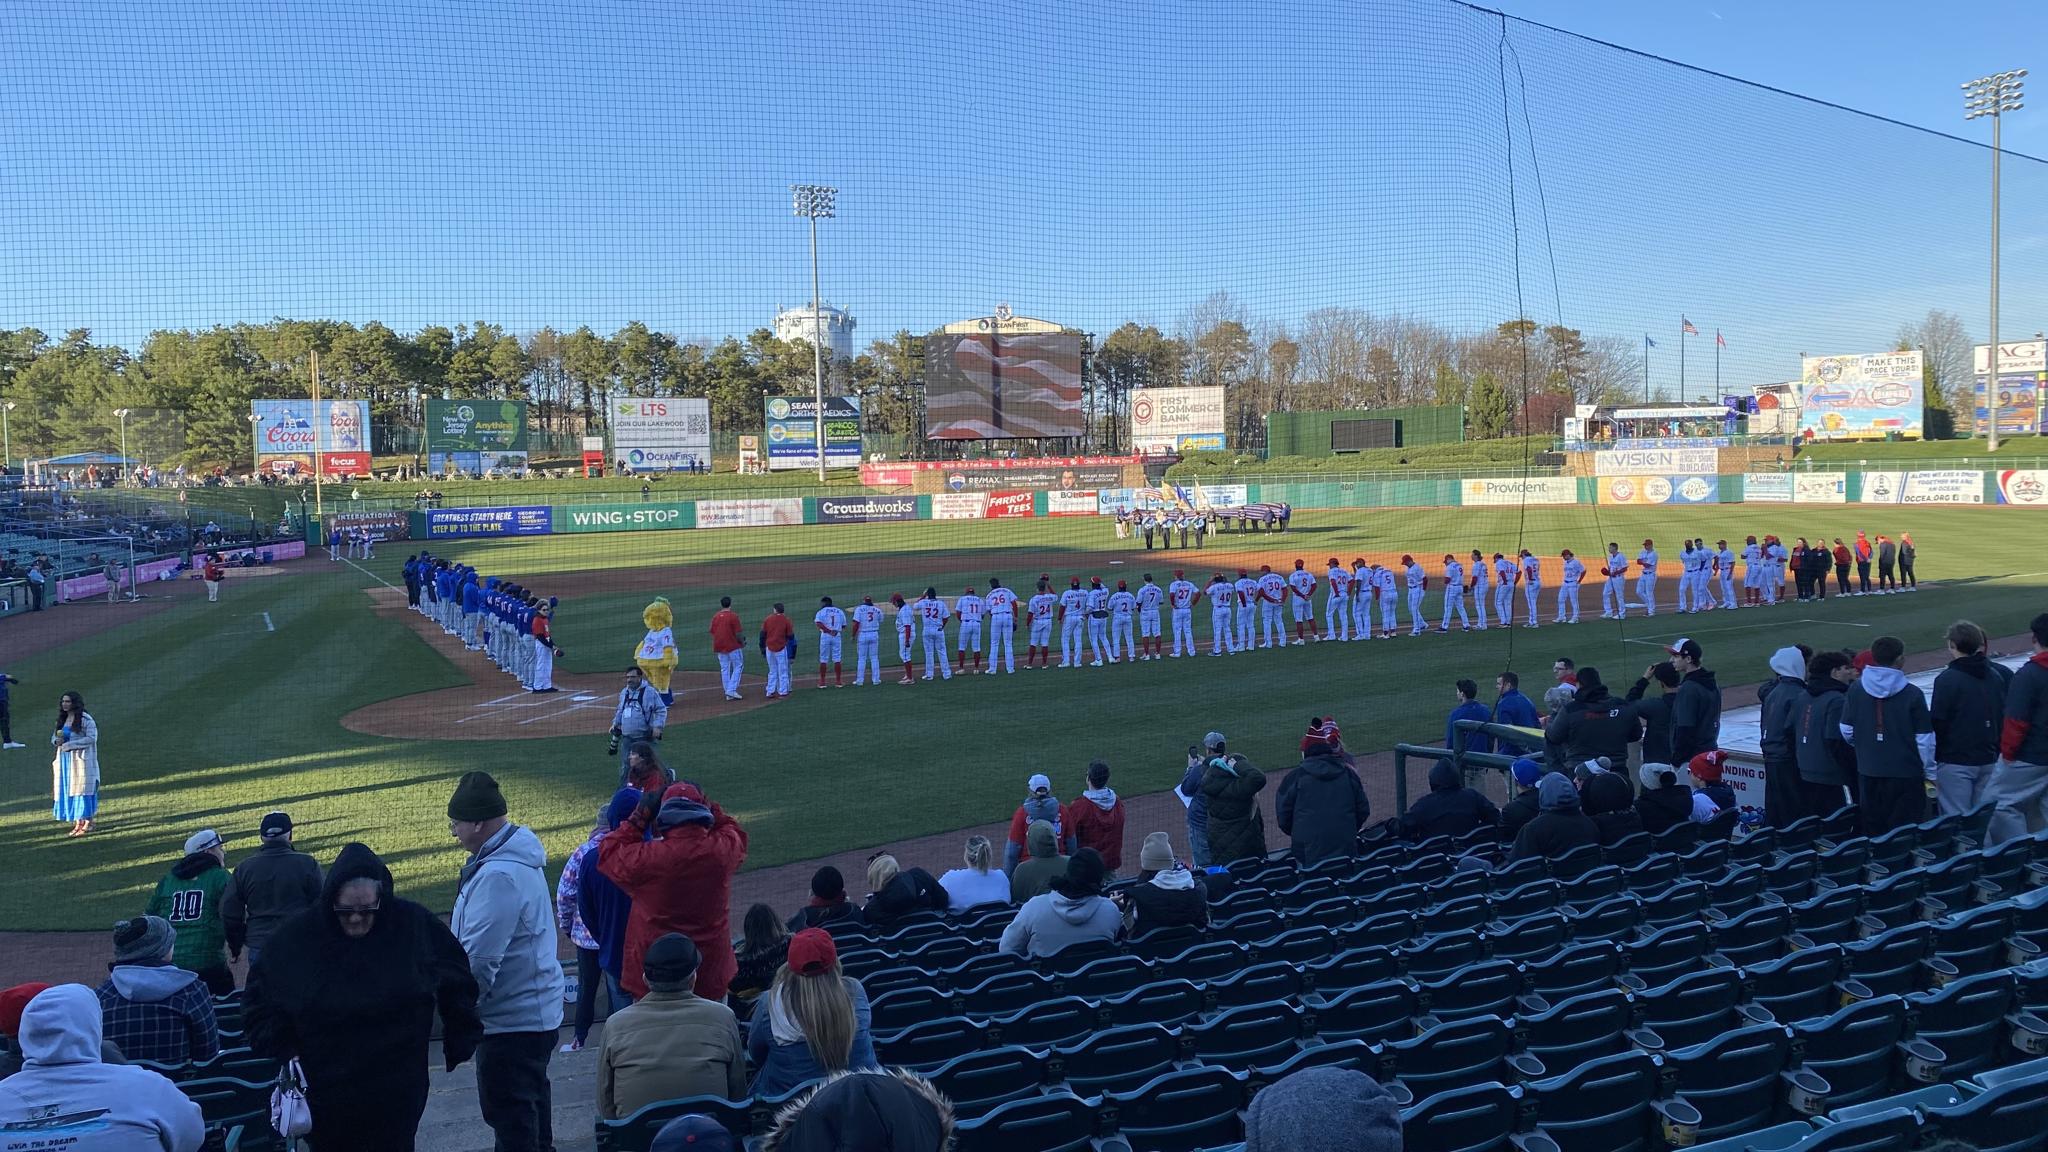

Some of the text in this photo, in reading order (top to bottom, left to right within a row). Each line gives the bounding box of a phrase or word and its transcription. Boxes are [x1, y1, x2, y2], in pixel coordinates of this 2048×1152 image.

[1867, 358, 1893, 366] MAKE
[1160, 397, 1191, 405] FIRST
[641, 403, 667, 416] LTS
[1160, 404, 1221, 414] COMMERCE
[1160, 414, 1189, 422] BANK
[446, 422, 468, 430] Jersey
[475, 422, 513, 430] Anything
[267, 426, 315, 443] Coors
[276, 443, 310, 451] LIGHT
[1680, 463, 1714, 472] BLUECLAWS
[1486, 482, 1547, 494] Provident
[989, 493, 1032, 507] FARRO'S
[1101, 496, 1129, 504] Corona
[823, 500, 912, 514] Groundworks
[1007, 503, 1031, 513] TEES
[338, 512, 396, 520] INTERNATIONAL
[433, 512, 514, 523] GREATNESS STARTS HERE.
[572, 509, 679, 525] WING STOP
[433, 523, 504, 534] STEP UP TO THE PLATE.
[1268, 582, 1280, 591] 30
[993, 594, 1005, 605] 26
[1149, 593, 1155, 602] 7
[1179, 590, 1189, 599] 27
[1122, 602, 1128, 612] 2
[867, 612, 874, 622] 3
[925, 607, 939, 619] 32
[1610, 709, 1619, 718] 27
[1723, 765, 1765, 779] NDING O
[169, 890, 204, 921] 10
[48, 1137, 78, 1146] DREAM
